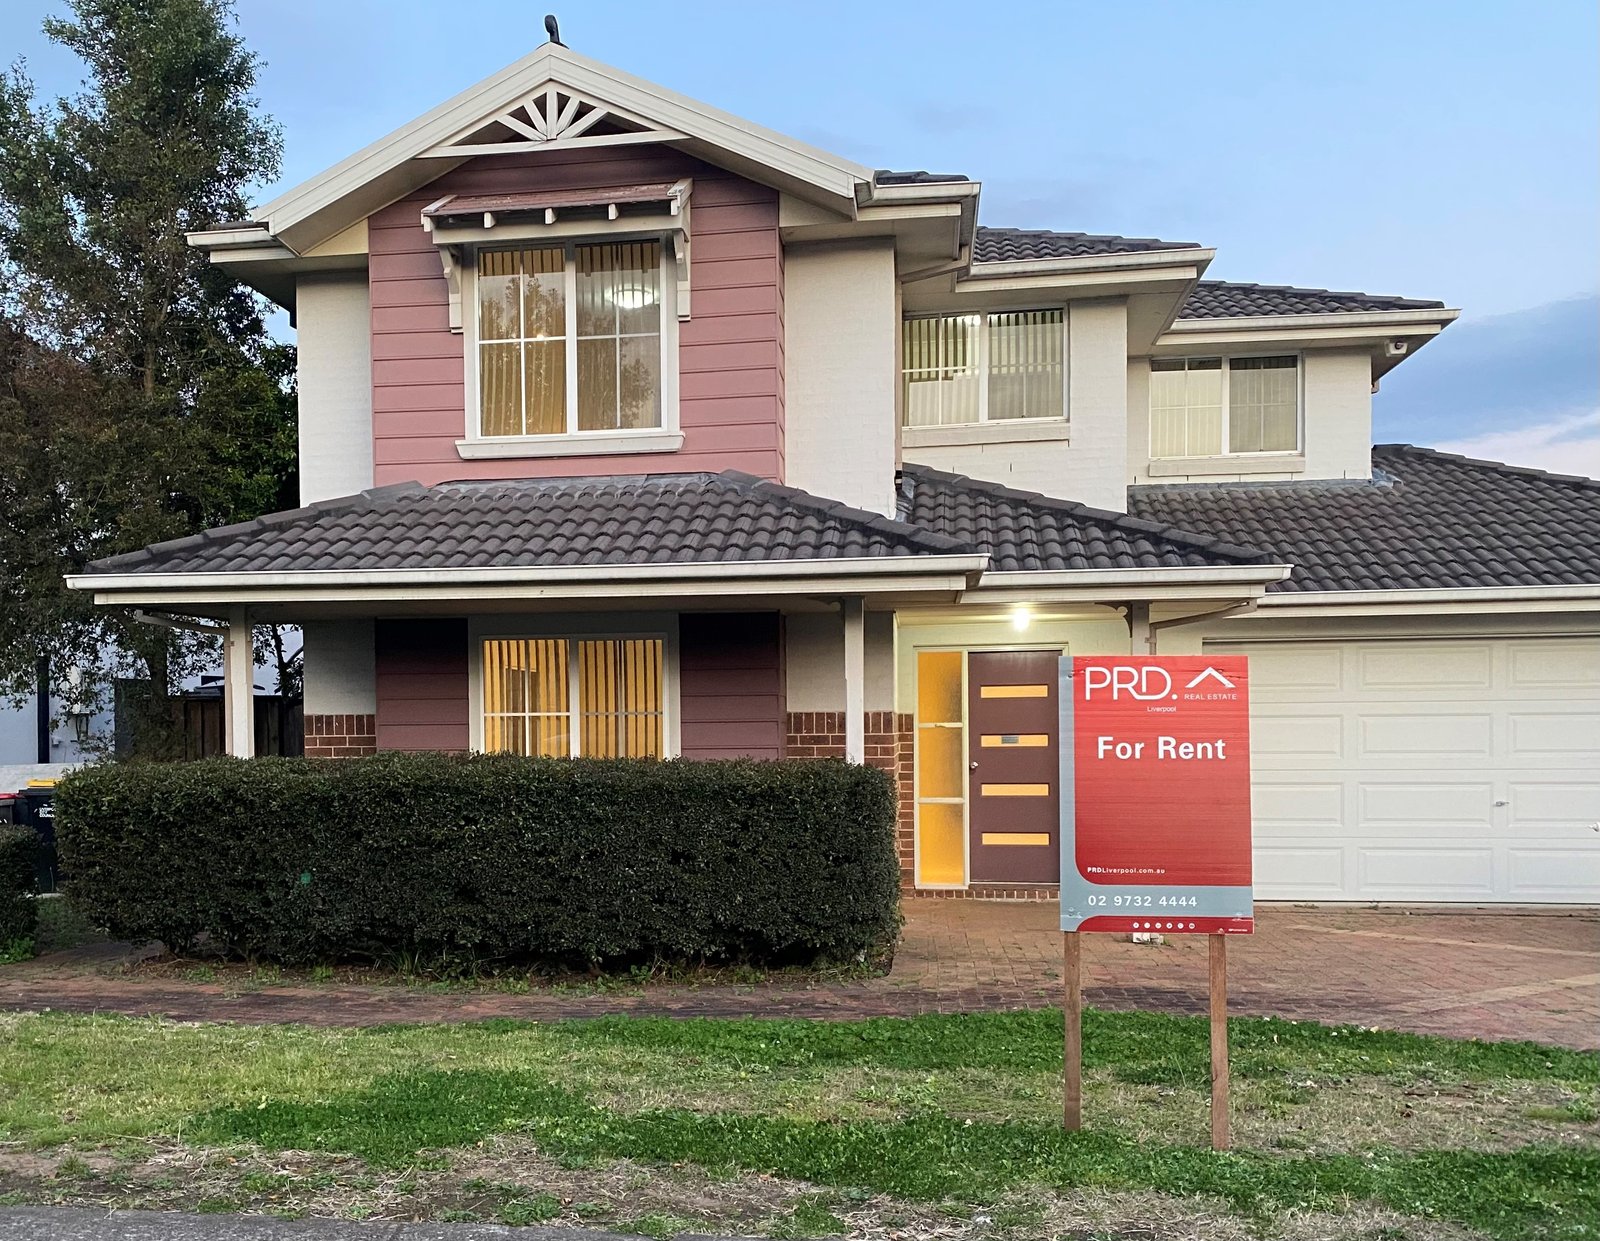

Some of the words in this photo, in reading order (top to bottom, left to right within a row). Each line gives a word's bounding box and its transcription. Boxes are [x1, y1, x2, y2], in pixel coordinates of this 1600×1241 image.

[1097, 736, 1145, 760] For
[1157, 736, 1227, 760] Rent
[1087, 866, 1166, 875] PRDLiverpool.com.au
[1087, 895, 1107, 906] 02
[1113, 895, 1152, 907] 9732
[1158, 896, 1198, 907] 4444
